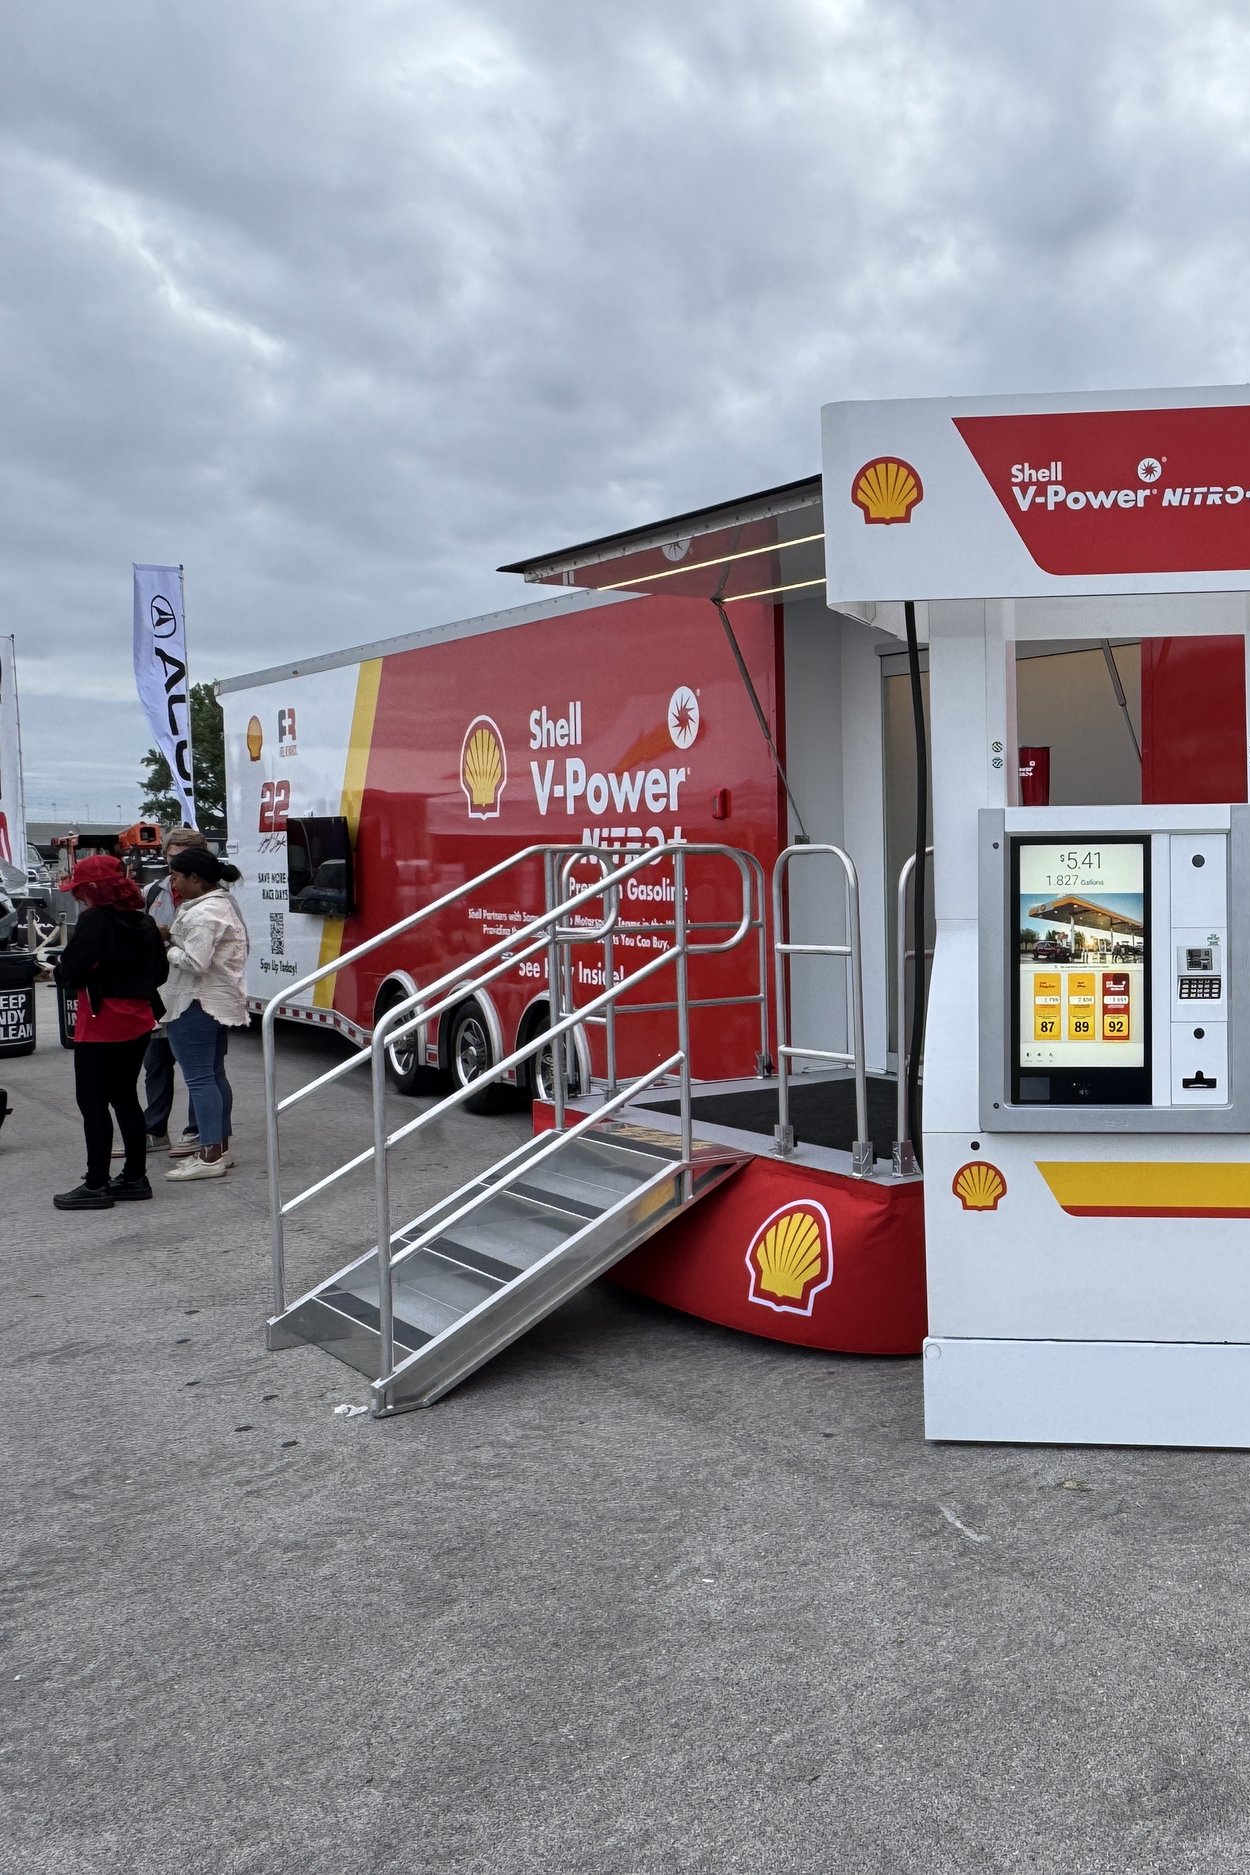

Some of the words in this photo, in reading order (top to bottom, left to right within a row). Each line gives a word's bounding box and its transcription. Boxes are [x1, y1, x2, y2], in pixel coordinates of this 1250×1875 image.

[1011, 461, 1062, 482] Shell
[1012, 485, 1151, 511] V-Power
[530, 701, 581, 749] Shell
[530, 757, 686, 815] V-Power
[259, 780, 290, 832] 22
[0, 994, 26, 1009] EEP
[0, 1009, 26, 1025] NDY
[0, 1024, 33, 1040] LEAN
[1040, 1021, 1055, 1033] 87
[1074, 1021, 1089, 1033] 89
[1108, 1021, 1124, 1033] 92
